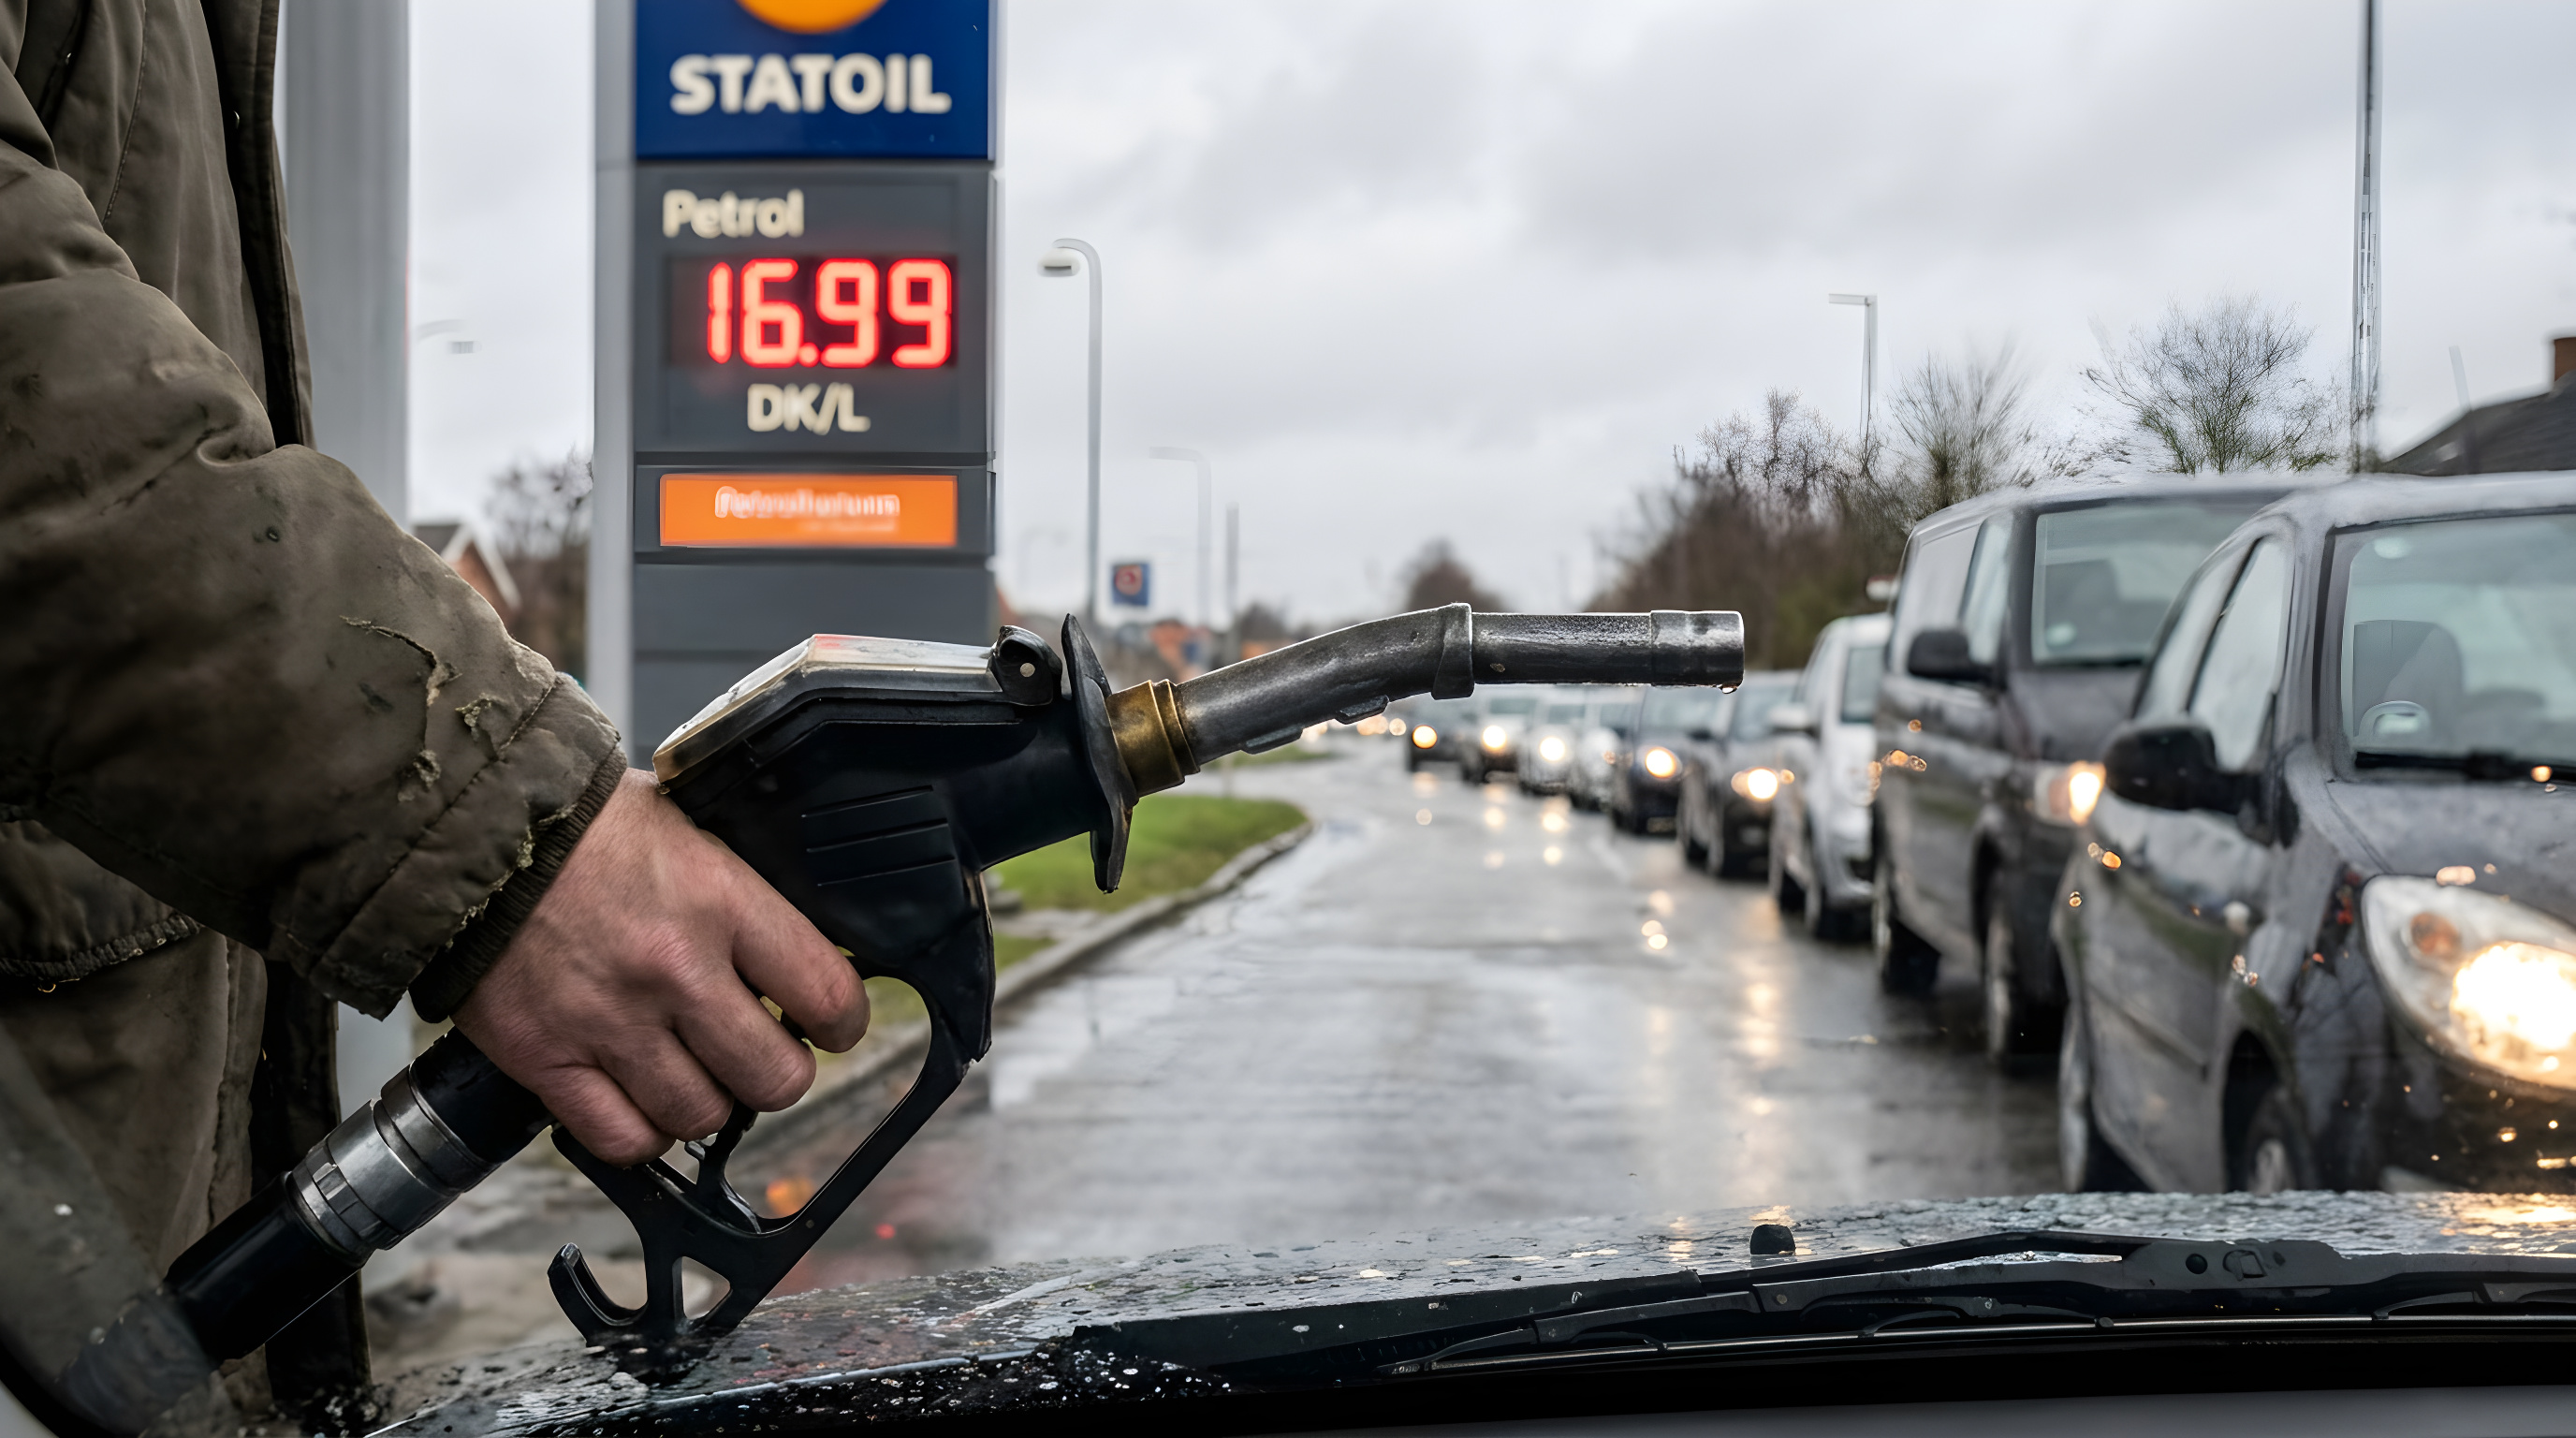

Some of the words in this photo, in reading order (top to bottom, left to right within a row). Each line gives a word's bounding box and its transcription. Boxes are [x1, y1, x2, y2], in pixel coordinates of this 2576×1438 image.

[670, 54, 951, 113] STATOIL
[663, 190, 803, 238] Petrol
[707, 258, 952, 368] 16.99
[748, 383, 870, 434] DK/L
